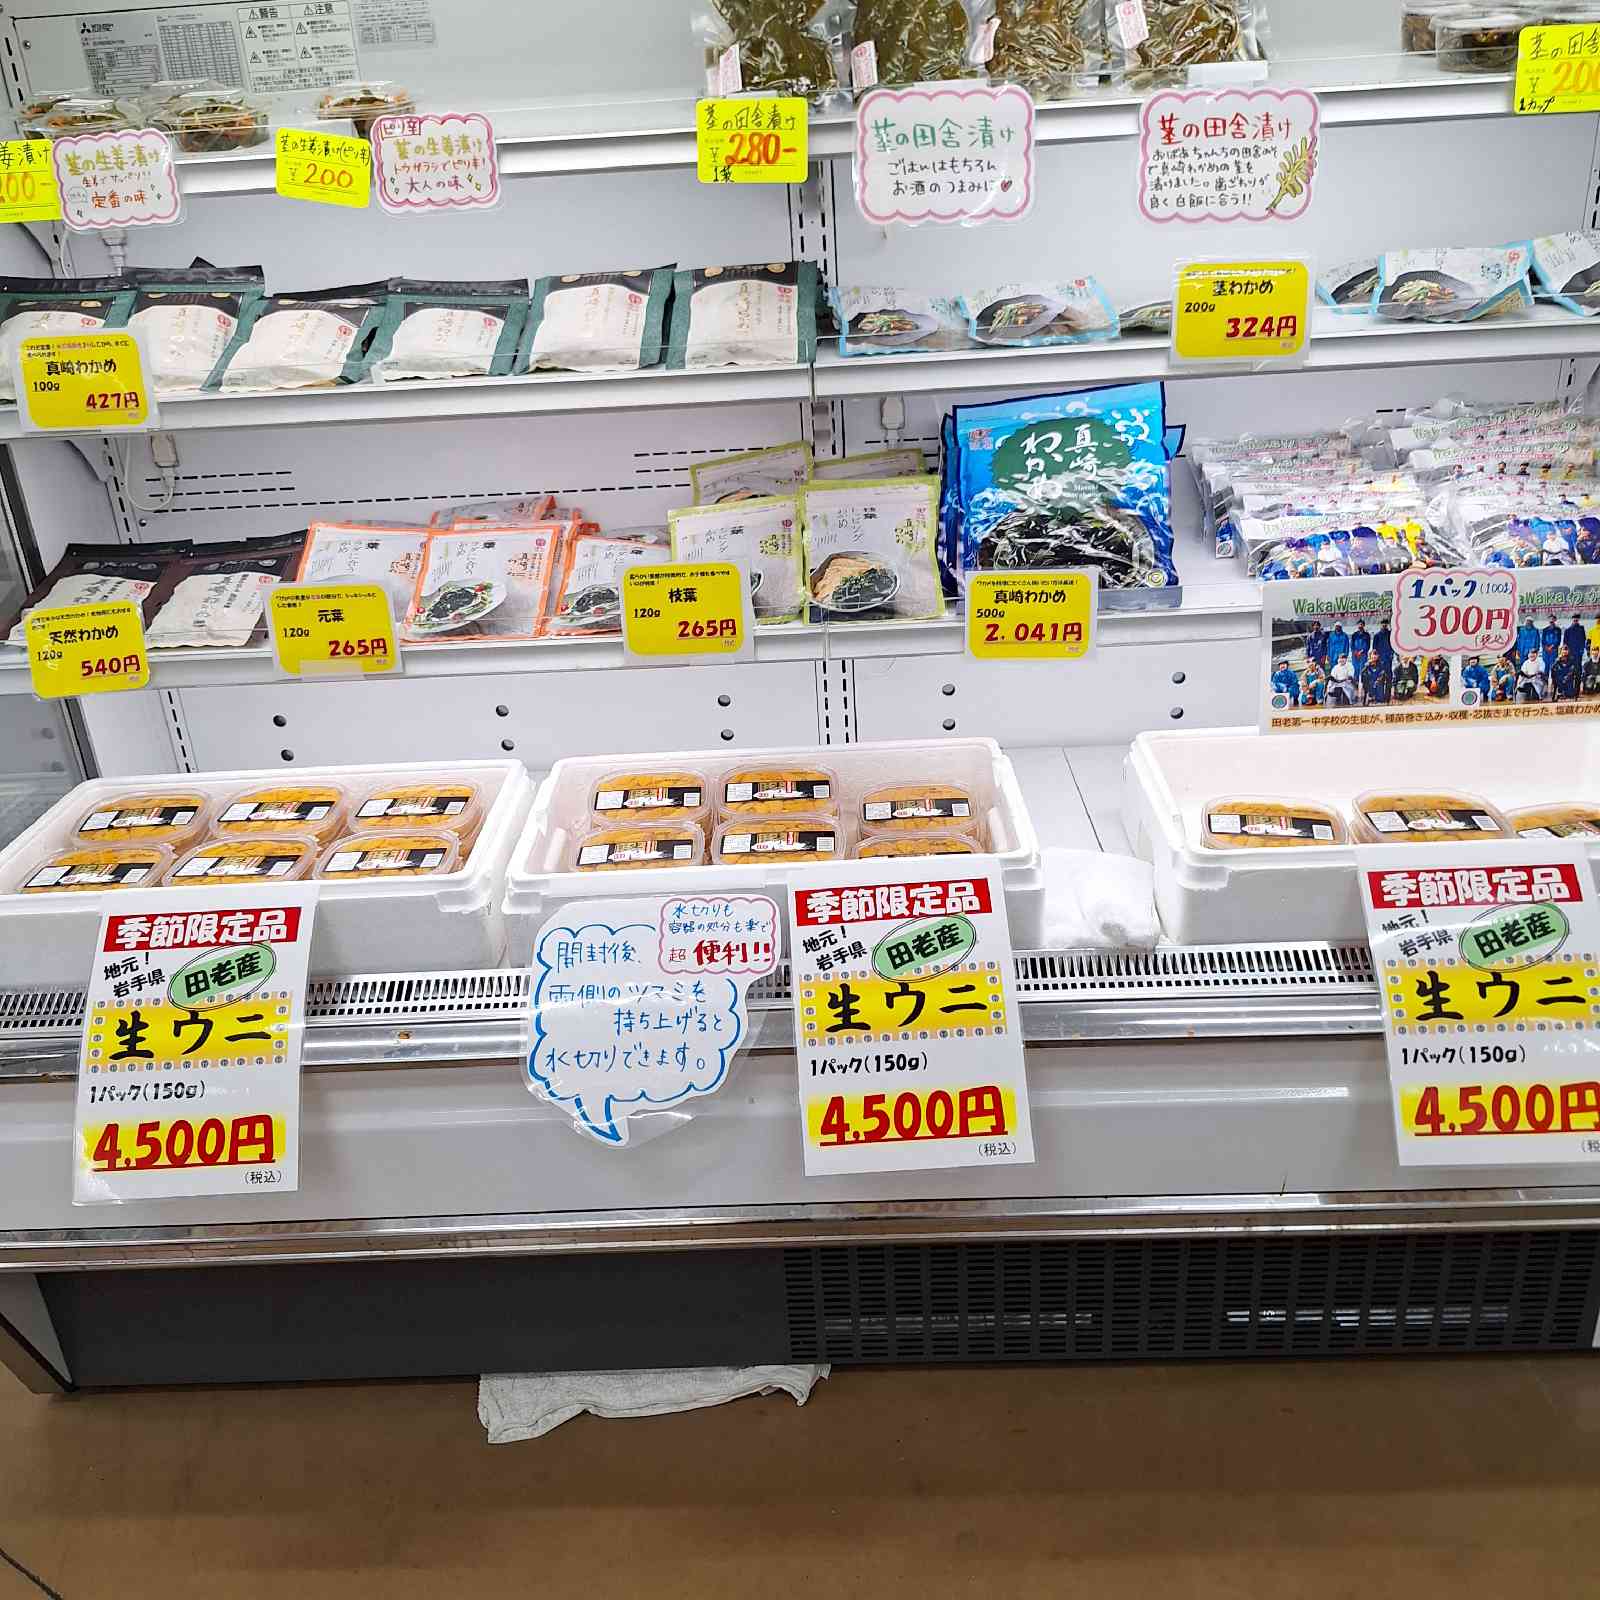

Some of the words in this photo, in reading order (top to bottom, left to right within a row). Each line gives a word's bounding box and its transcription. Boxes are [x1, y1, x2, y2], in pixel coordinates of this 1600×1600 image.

[871, 115, 1015, 152] 茎の田舎漬け
[1158, 112, 1292, 145] 茎の田舎漬け
[303, 162, 353, 188] 200
[888, 157, 998, 176] ごはんはもちろん
[0, 171, 35, 204] 00
[406, 175, 464, 194] 大人の味
[91, 190, 146, 208] 定番の味
[1212, 279, 1274, 296] 茎わかめ
[1225, 315, 1297, 338] 324円
[45, 358, 118, 376] 真崎わかめ
[32, 381, 60, 392] 100g
[85, 391, 140, 409] 427円
[668, 587, 697, 603] 枝葉
[993, 589, 1067, 604] 真崎わかめ
[1408, 577, 1478, 599] 1パック
[317, 608, 345, 623] 元葉
[633, 607, 661, 618] 120g
[1414, 604, 1511, 637] 300円
[48, 624, 119, 645] 天然わかめ
[678, 618, 737, 638] 265円
[328, 638, 388, 657] 265円
[81, 654, 141, 677] 540円
[1381, 867, 1570, 907] 季節限定品
[672, 904, 733, 919] 水切りも
[807, 881, 981, 923] 季節限定品
[116, 909, 288, 949] 季節限定品
[1474, 911, 1556, 958] 田老産
[668, 945, 687, 962] 超
[693, 940, 770, 966] 便利!!
[816, 940, 867, 971] 岩手県
[885, 923, 964, 970] 田老産
[1399, 929, 1454, 957] 岩手県
[113, 968, 166, 998] 岩手県
[184, 951, 262, 998] 田老産
[549, 981, 706, 1008] 両側のツマミを
[1415, 971, 1587, 1021] 生ウニ
[825, 983, 987, 1032] 生ウニ
[613, 1007, 723, 1036] 持ち上げると
[109, 1010, 272, 1061] 生ウニ
[545, 1042, 705, 1072] 水切りできます。
[811, 1052, 928, 1076] 1パック(150g)
[978, 1142, 1017, 1156] (税込)
[244, 1171, 282, 1184] (税込)
